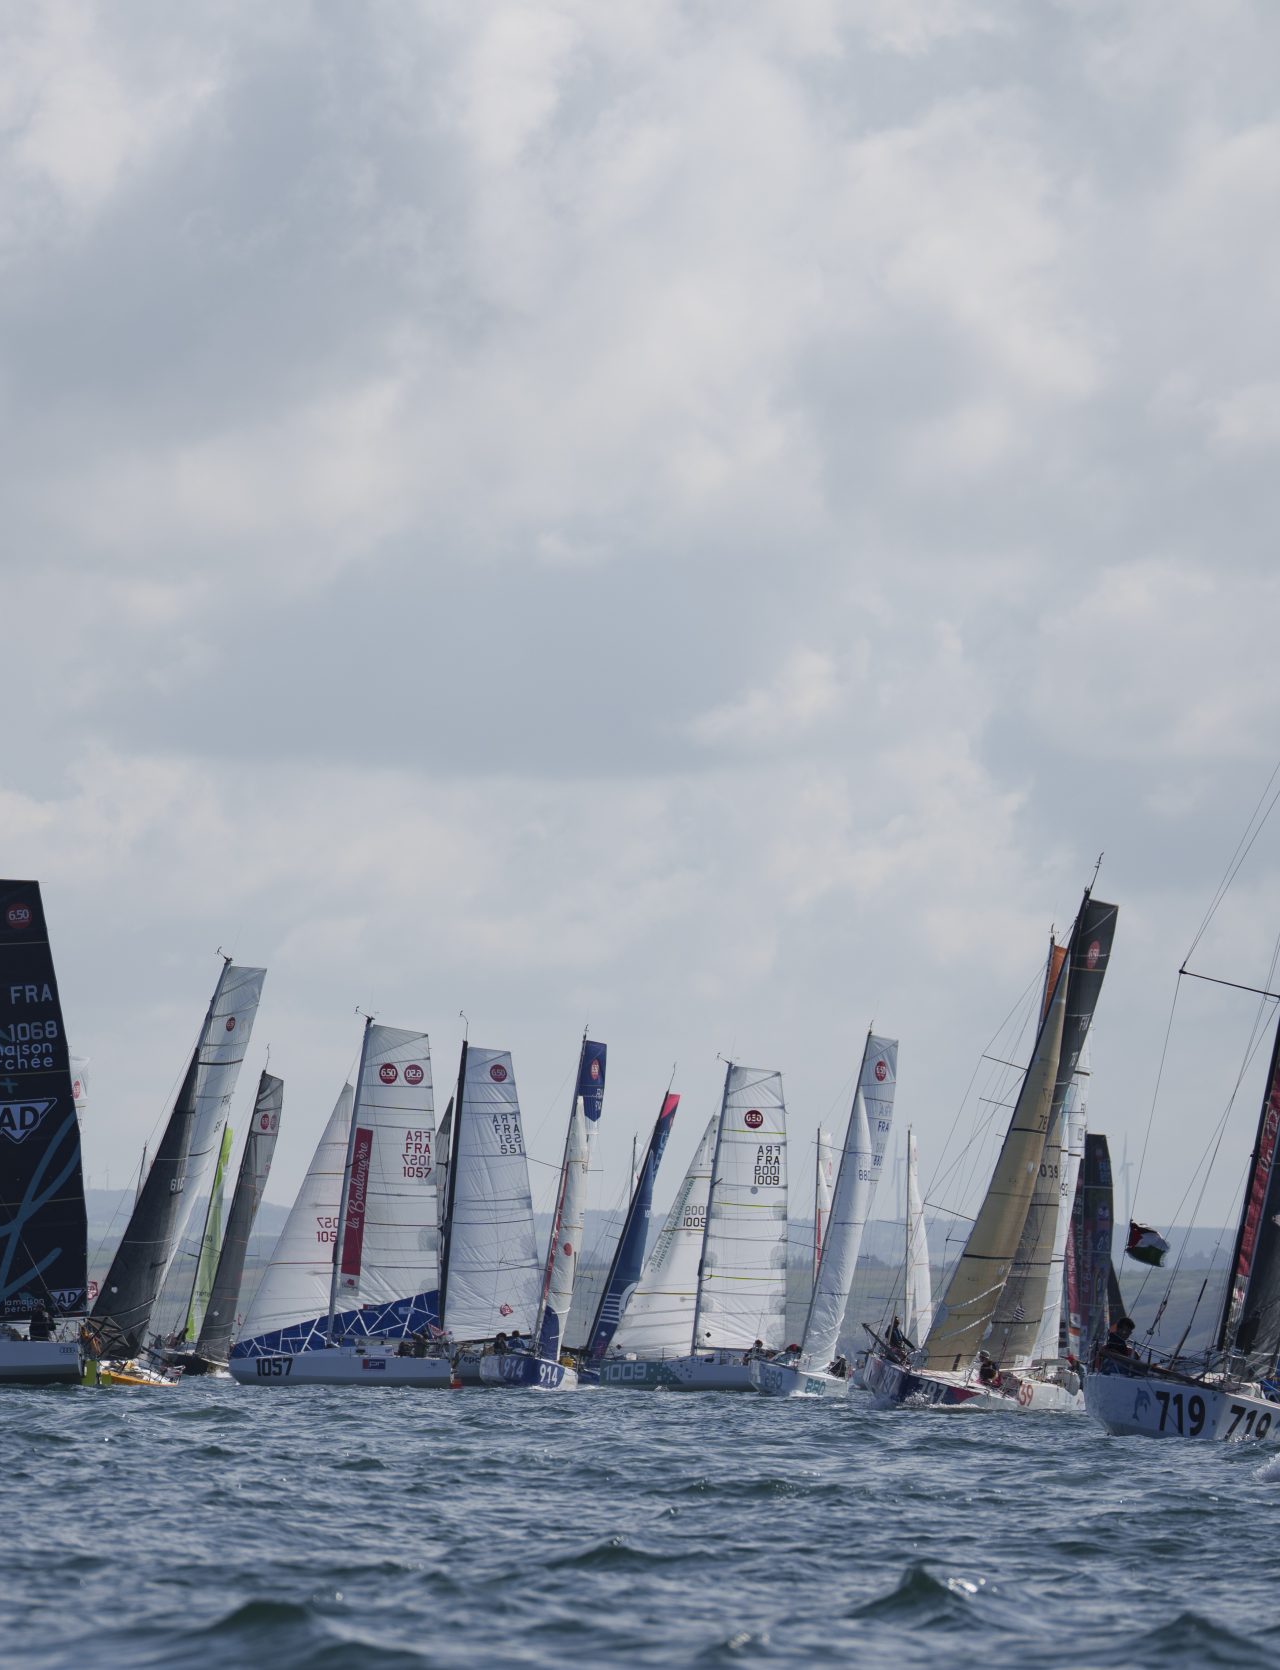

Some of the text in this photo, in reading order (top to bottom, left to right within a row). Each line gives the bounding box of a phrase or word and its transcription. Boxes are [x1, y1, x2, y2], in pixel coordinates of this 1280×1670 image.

[10, 984, 53, 1004] FRA
[8, 1021, 57, 1042] 1068
[495, 1125, 520, 1134] FRA
[405, 1143, 431, 1154] FRA
[500, 1145, 523, 1154] 551
[757, 1156, 780, 1165] FRA
[403, 1167, 433, 1178] 1057
[754, 1175, 780, 1185] 1009
[316, 1231, 338, 1243] 105
[56, 1291, 77, 1305] AD
[4, 1306, 38, 1314] perch
[256, 1357, 293, 1377] 1057
[604, 1362, 647, 1380] 1009
[540, 1363, 560, 1386] 914
[1019, 1384, 1034, 1406] 39
[1156, 1391, 1206, 1437] 719
[1224, 1404, 1272, 1441] 719
